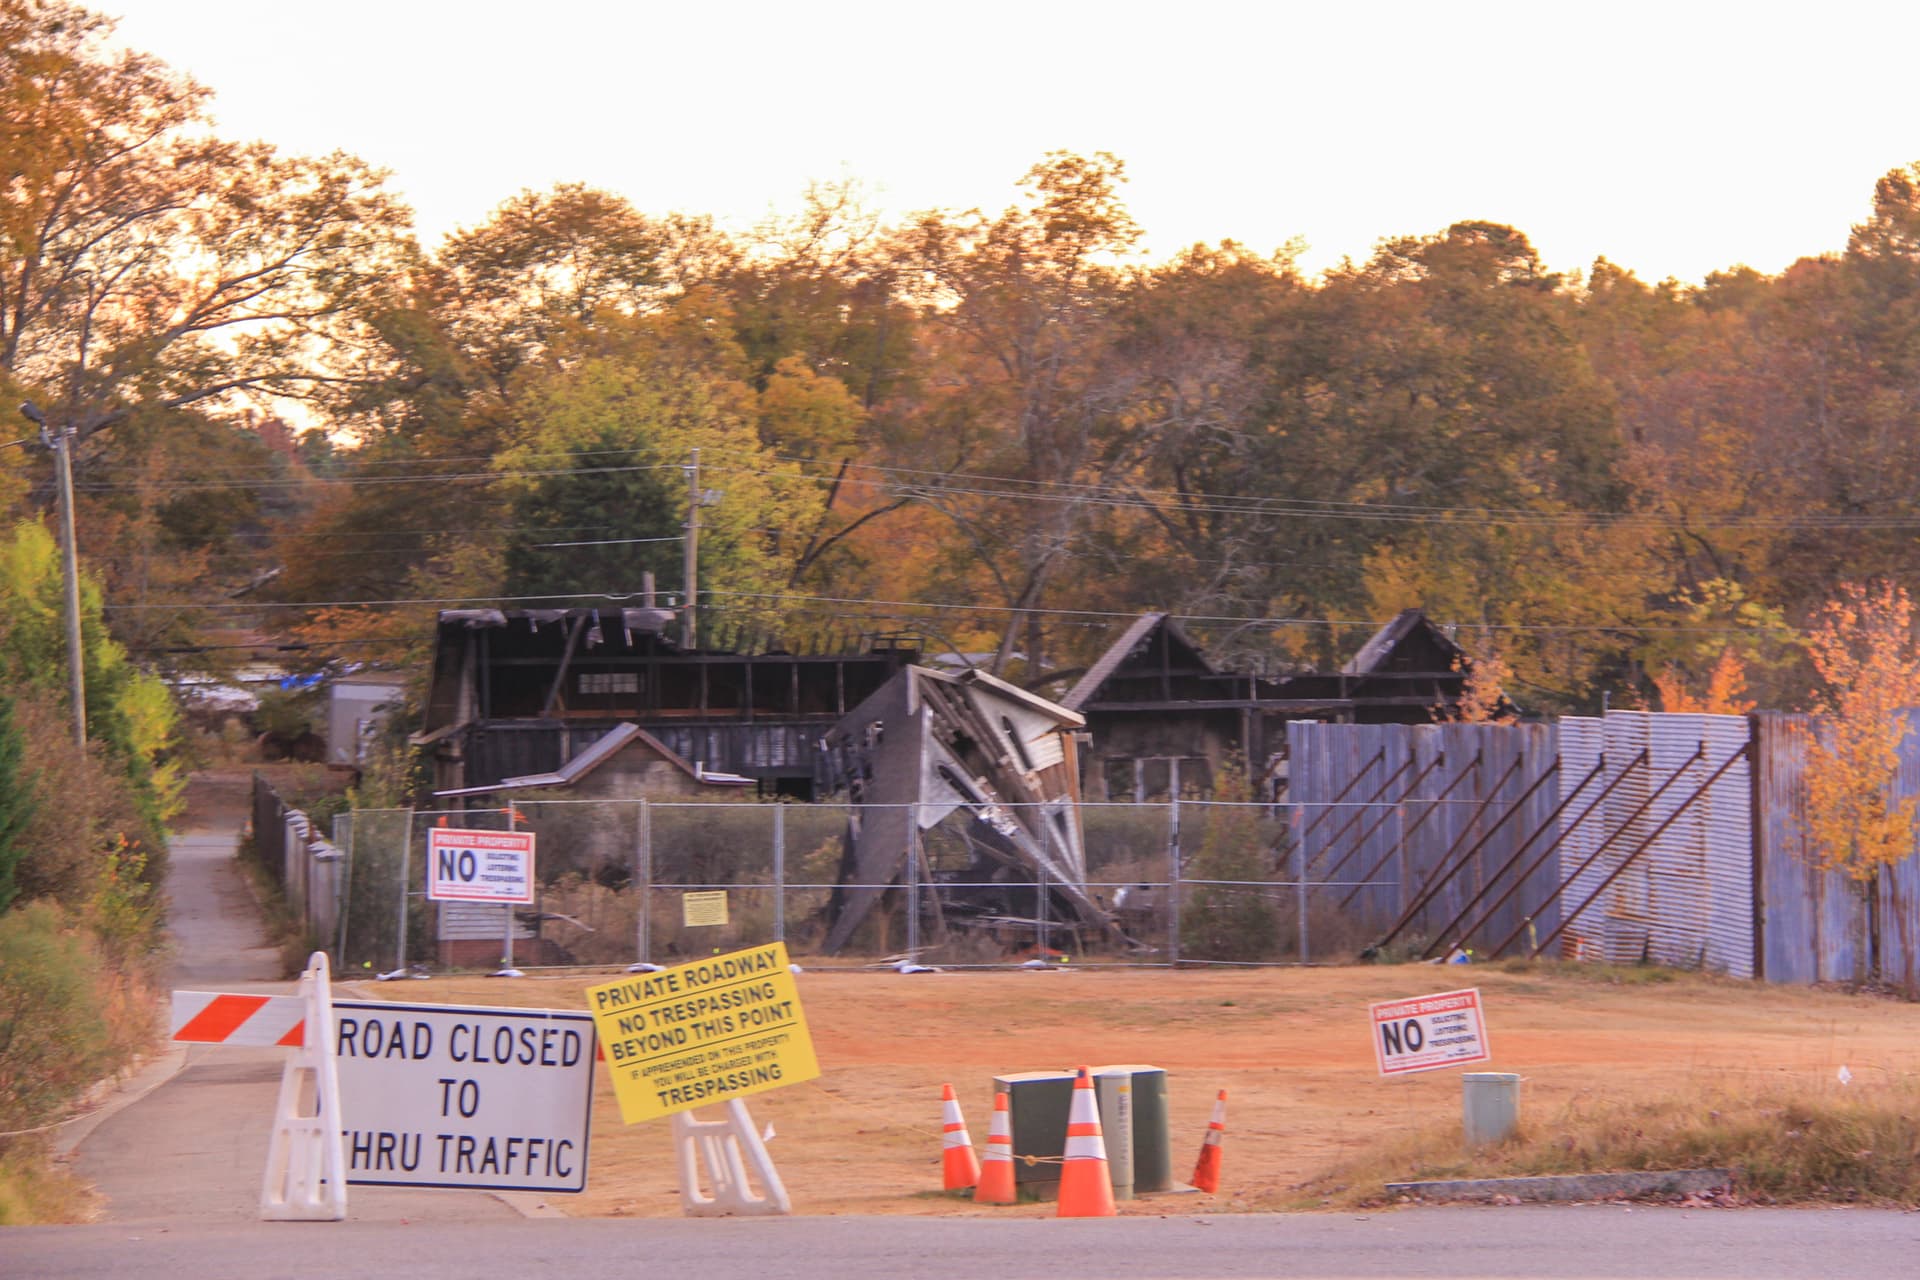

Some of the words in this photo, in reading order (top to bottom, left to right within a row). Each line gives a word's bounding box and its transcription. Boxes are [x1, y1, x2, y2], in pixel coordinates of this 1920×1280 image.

[439, 849, 476, 882] NO
[596, 973, 680, 1010] PRIVATE
[684, 950, 778, 989] ROADWAY
[611, 1027, 687, 1060] BEYOND
[691, 1015, 734, 1041] THIS
[740, 1001, 793, 1029] POINT
[618, 1013, 646, 1035] NO
[650, 982, 776, 1025] TRESPASSING
[338, 1017, 433, 1060] ROAD
[450, 1023, 581, 1067] CLOSED
[642, 1054, 705, 1077] APPREHENDED
[722, 1044, 742, 1056] THIS
[745, 1033, 790, 1050] PROPERTY
[1381, 1018, 1423, 1055] NO
[653, 1076, 673, 1088] YOU
[674, 1071, 695, 1082] WILL
[698, 1066, 710, 1077] BE
[711, 1056, 753, 1073] CHARGED
[754, 1050, 778, 1063] WITH
[657, 1063, 783, 1107] TRESPASSING
[439, 1078, 480, 1118] TO
[341, 1130, 422, 1172] HRU
[437, 1133, 574, 1178] TRAFFIC
